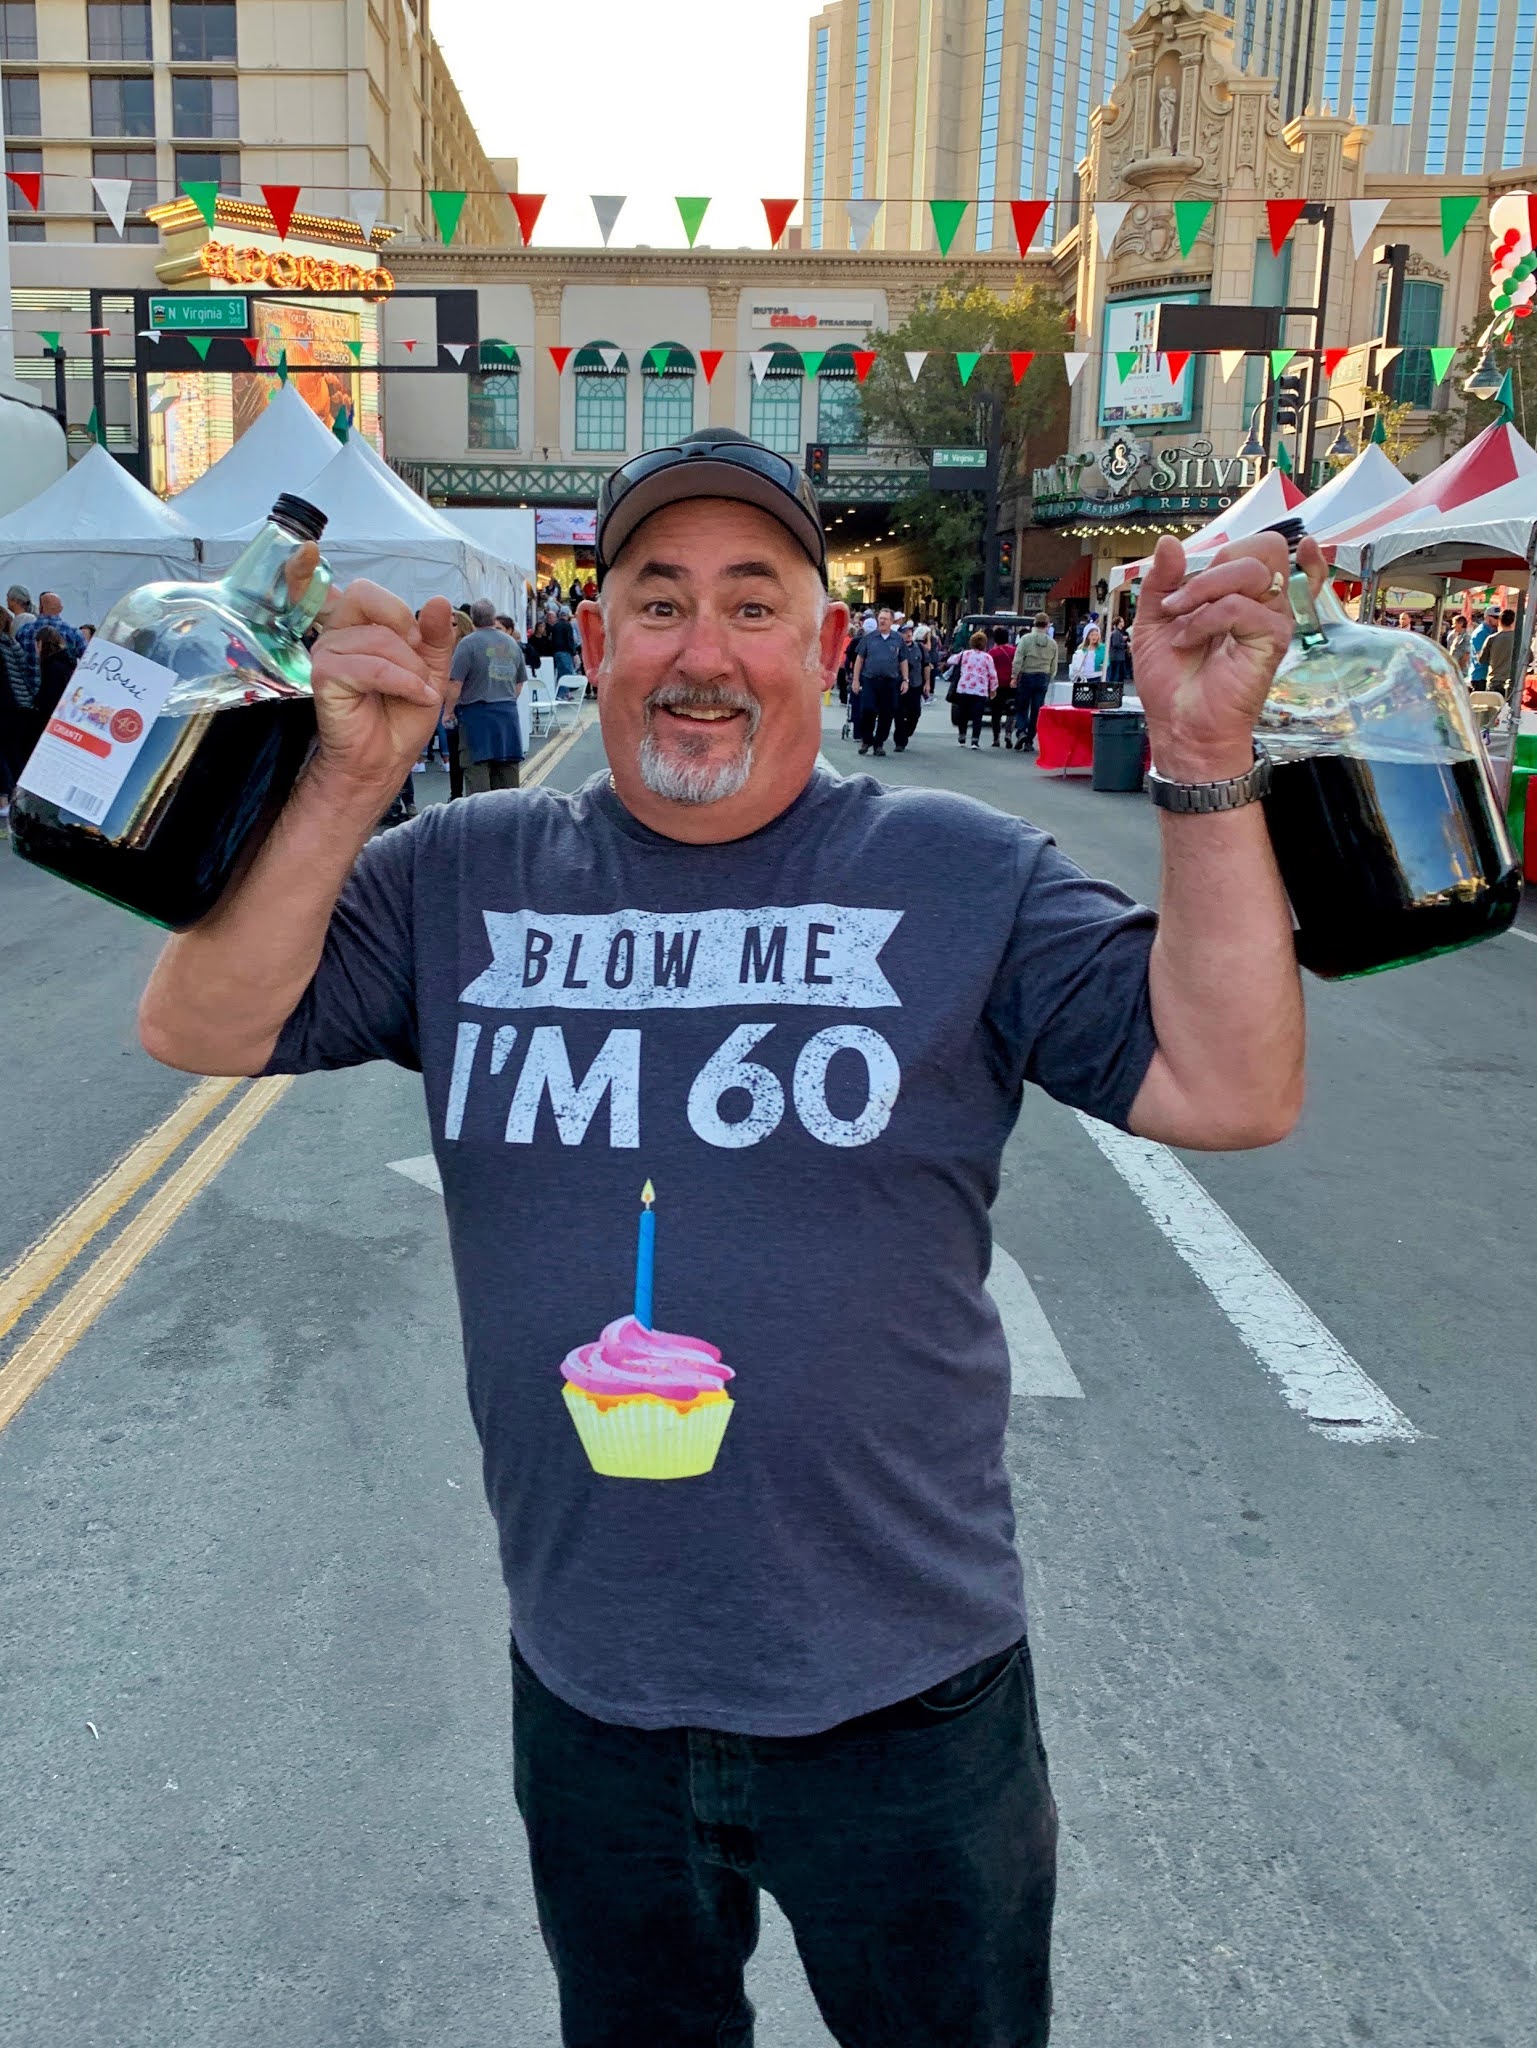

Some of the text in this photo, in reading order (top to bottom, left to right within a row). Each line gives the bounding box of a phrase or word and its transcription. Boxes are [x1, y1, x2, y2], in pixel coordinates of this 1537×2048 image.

[168, 306, 176, 320] N
[182, 306, 222, 324] Virginia
[228, 301, 241, 315] St
[1108, 501, 1131, 514] 1895
[1160, 496, 1232, 508] RESO
[96, 656, 147, 701] Rossi
[521, 922, 836, 990] BLOW ME
[444, 1021, 901, 1149] I'M 60
